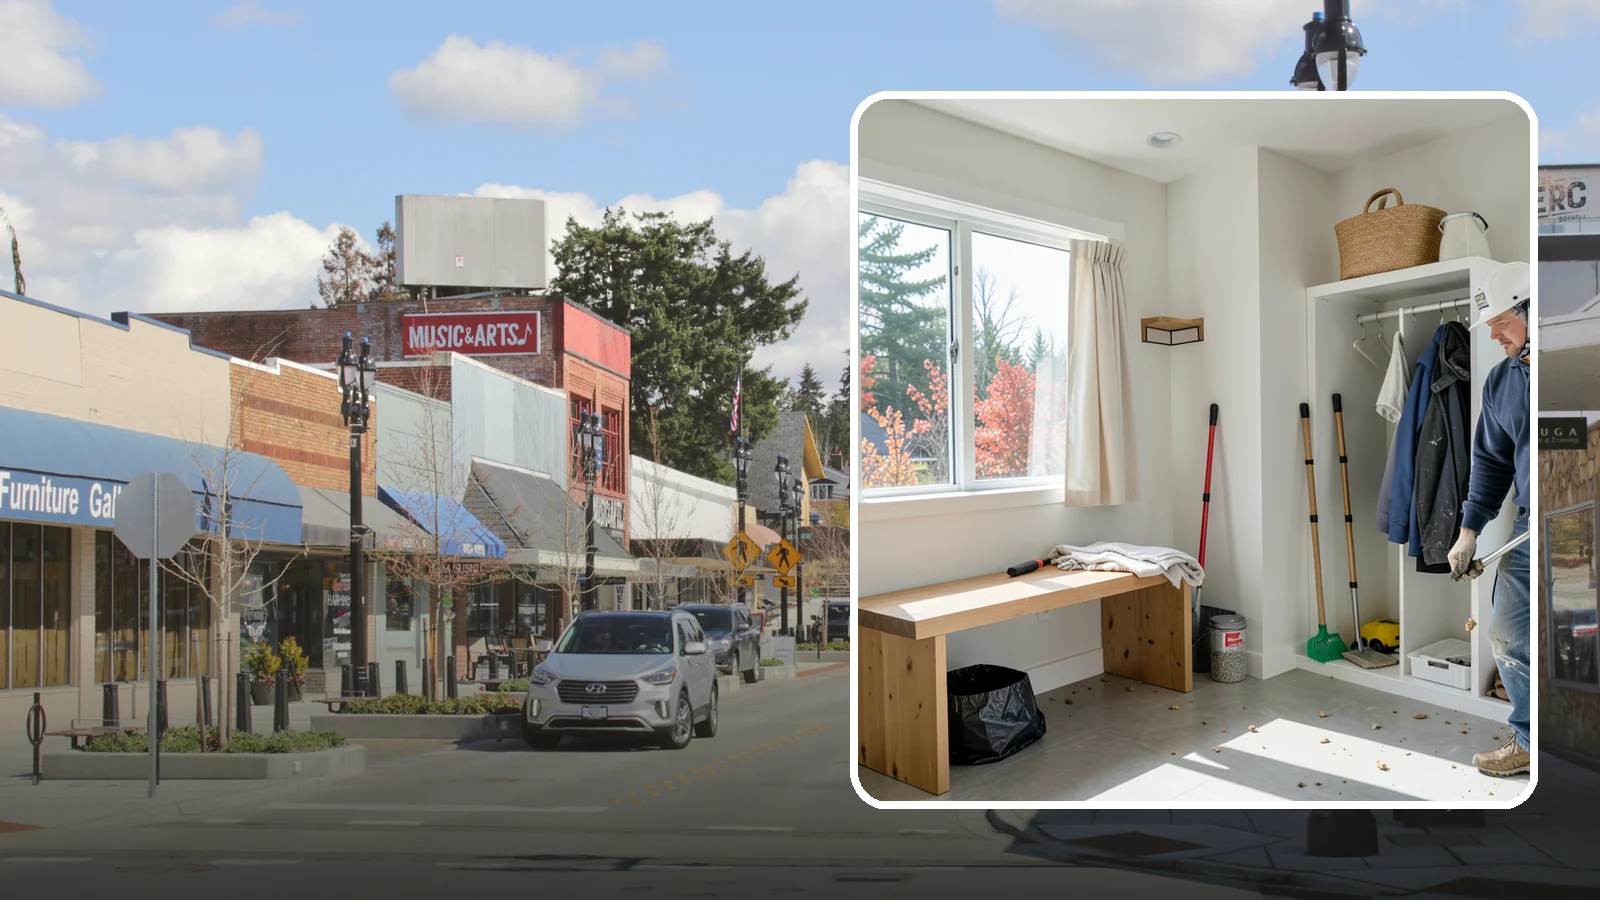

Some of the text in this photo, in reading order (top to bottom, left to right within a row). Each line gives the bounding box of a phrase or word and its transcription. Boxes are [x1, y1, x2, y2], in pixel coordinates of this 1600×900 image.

[409, 323, 519, 349] MUSIC&ARTS
[0, 471, 79, 515] Furniture
[454, 563, 479, 574] SUSHI
